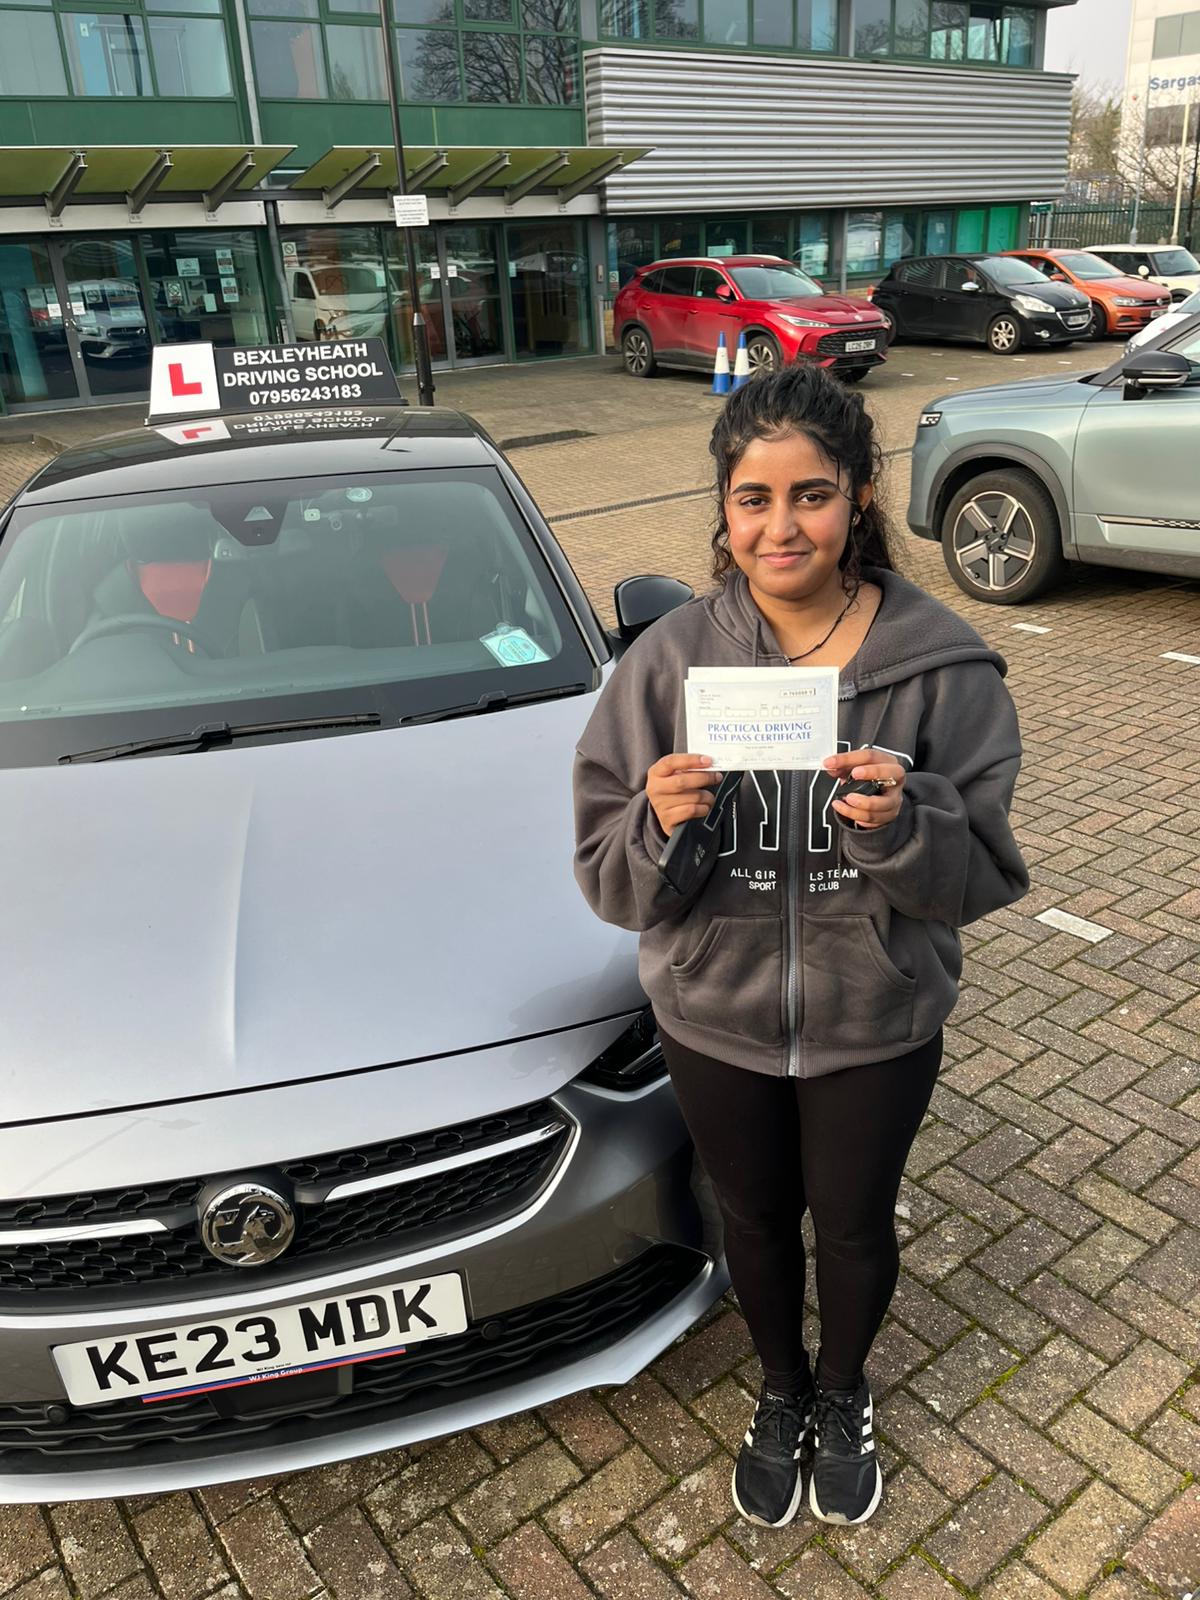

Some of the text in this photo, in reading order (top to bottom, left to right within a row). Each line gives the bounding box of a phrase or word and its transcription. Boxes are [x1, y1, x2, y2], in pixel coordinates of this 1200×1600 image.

[233, 343, 367, 366] BEXLEYHEATH
[168, 363, 202, 397] L
[224, 362, 383, 387] DRIVING SCHOOL
[250, 384, 361, 405] 07956243183
[707, 721, 812, 733] PRACTICAL DRIVING
[709, 731, 812, 742] TEST PASS CERTIFICATE
[730, 868, 858, 881] ALL GIR LS TEAM
[748, 881, 839, 893] SPORT S CLUB
[85, 1284, 438, 1390] KE23 MDK
[280, 1368, 303, 1376] Group
